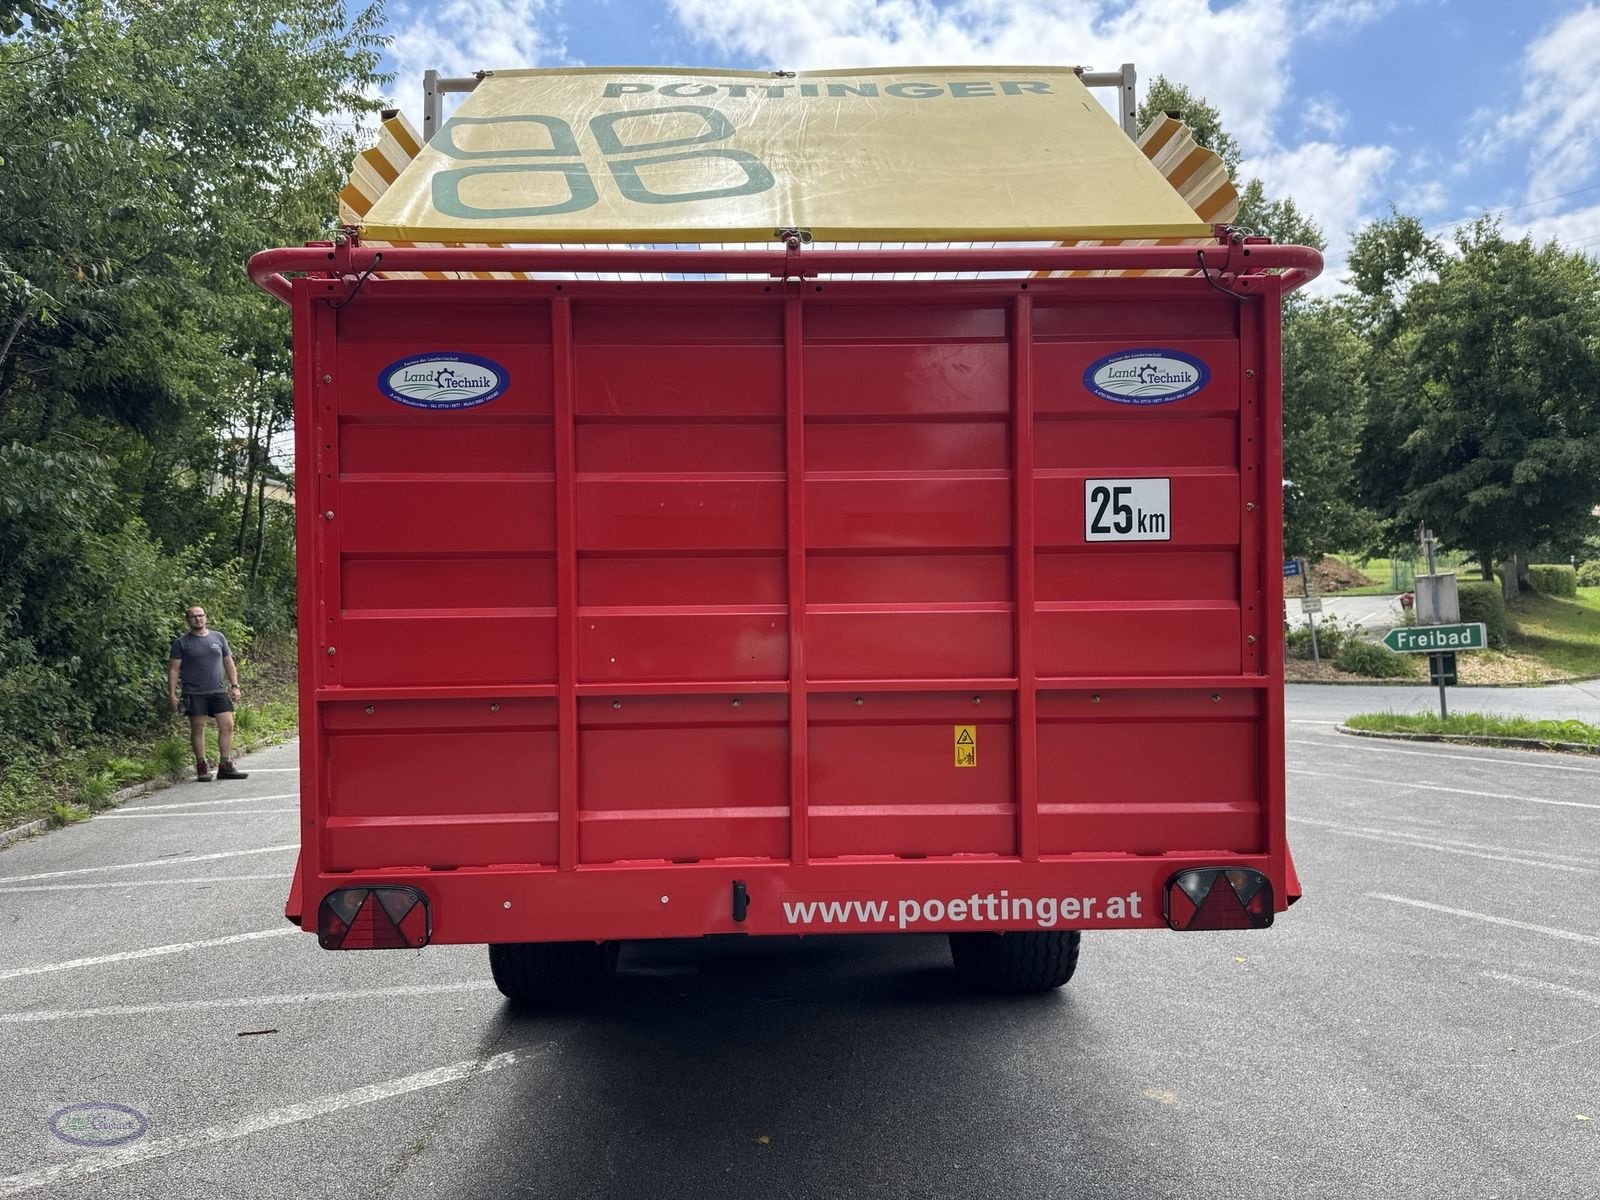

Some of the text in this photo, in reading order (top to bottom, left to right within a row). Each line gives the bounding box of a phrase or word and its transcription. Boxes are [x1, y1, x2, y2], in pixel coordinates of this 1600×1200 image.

[404, 371, 433, 382] Land
[1108, 367, 1137, 378] Land
[1147, 372, 1192, 384] Technik
[444, 377, 490, 388] Technik
[1090, 486, 1166, 534] 25 km
[1397, 628, 1472, 648] Freibad
[782, 890, 1142, 929] www.poettinger.at
